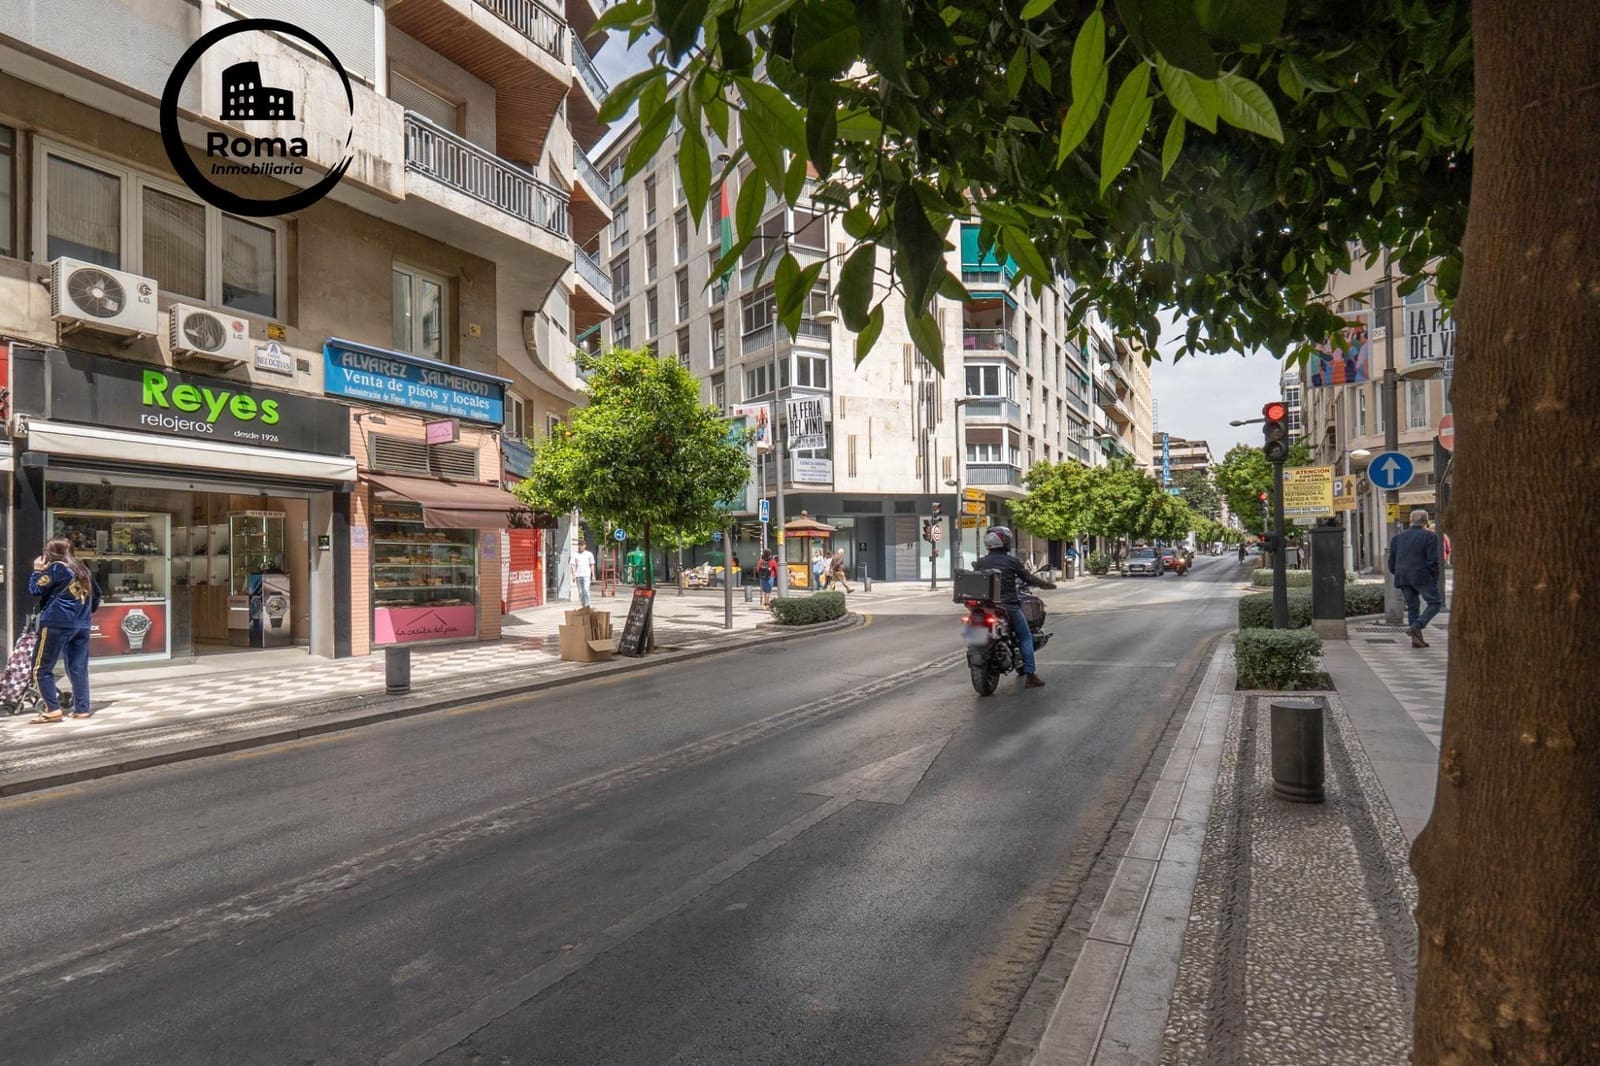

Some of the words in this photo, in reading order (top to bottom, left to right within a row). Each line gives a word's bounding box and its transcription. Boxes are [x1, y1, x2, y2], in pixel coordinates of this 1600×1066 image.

[138, 295, 150, 304] LG
[1410, 310, 1426, 335] LA
[1410, 334, 1435, 360] DEL
[342, 351, 408, 378] ALVAREZ
[142, 369, 280, 425] Reyes
[342, 368, 384, 389] Venta
[388, 378, 403, 392] de
[407, 384, 439, 400] pisos
[442, 391, 450, 402] y
[452, 391, 490, 409] locales
[788, 402, 798, 420] LA
[800, 399, 822, 419] FERIA
[141, 413, 214, 433] relojeros
[790, 419, 802, 437] DEL
[803, 417, 823, 435] VINO
[234, 430, 259, 439] desde
[261, 433, 279, 442] 1926
[1334, 481, 1342, 496] P
